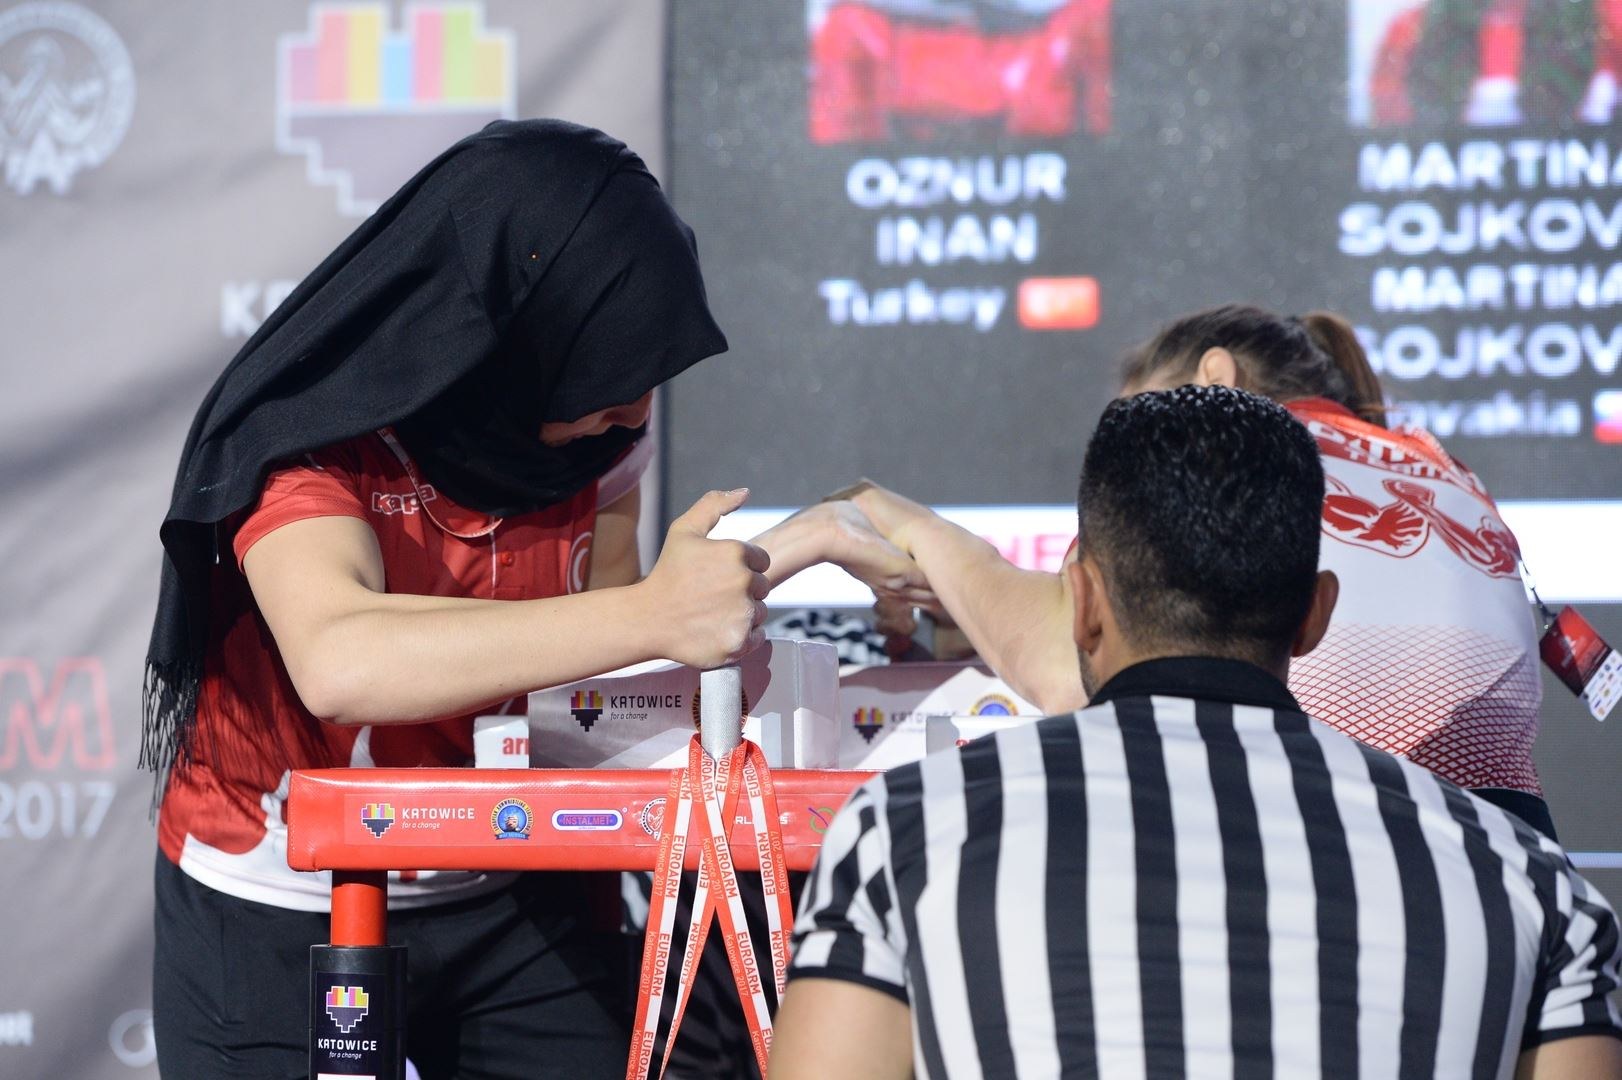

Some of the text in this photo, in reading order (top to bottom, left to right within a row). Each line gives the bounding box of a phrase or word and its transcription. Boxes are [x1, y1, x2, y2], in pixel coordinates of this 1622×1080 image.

[847, 153, 1066, 208] OZNUR
[1359, 140, 1622, 192] MARTIN
[877, 213, 1037, 266] INAN
[818, 279, 1007, 332] Turkey
[610, 695, 682, 709] KATOWICE
[610, 711, 620, 720] for
[626, 711, 648, 721] change
[402, 808, 475, 819] KATOWICE
[402, 820, 411, 829] for
[417, 821, 441, 830] change
[657, 832, 671, 873] Katowice
[666, 835, 684, 898] EUROARM
[714, 835, 738, 898] EUROARM
[757, 832, 776, 896] EUROARM
[770, 831, 787, 894] Katowice 2017
[654, 875, 664, 896] 2017
[651, 933, 670, 997] EUROARM
[681, 923, 700, 985] EUROARM
[737, 931, 761, 996] EUROARM
[640, 973, 650, 995] 2017
[735, 975, 749, 997] 2017
[317, 1038, 377, 1051] KATOWICE
[328, 1050, 337, 1059] for
[341, 1052, 362, 1060] change
[637, 1031, 654, 1080] EUROAR
